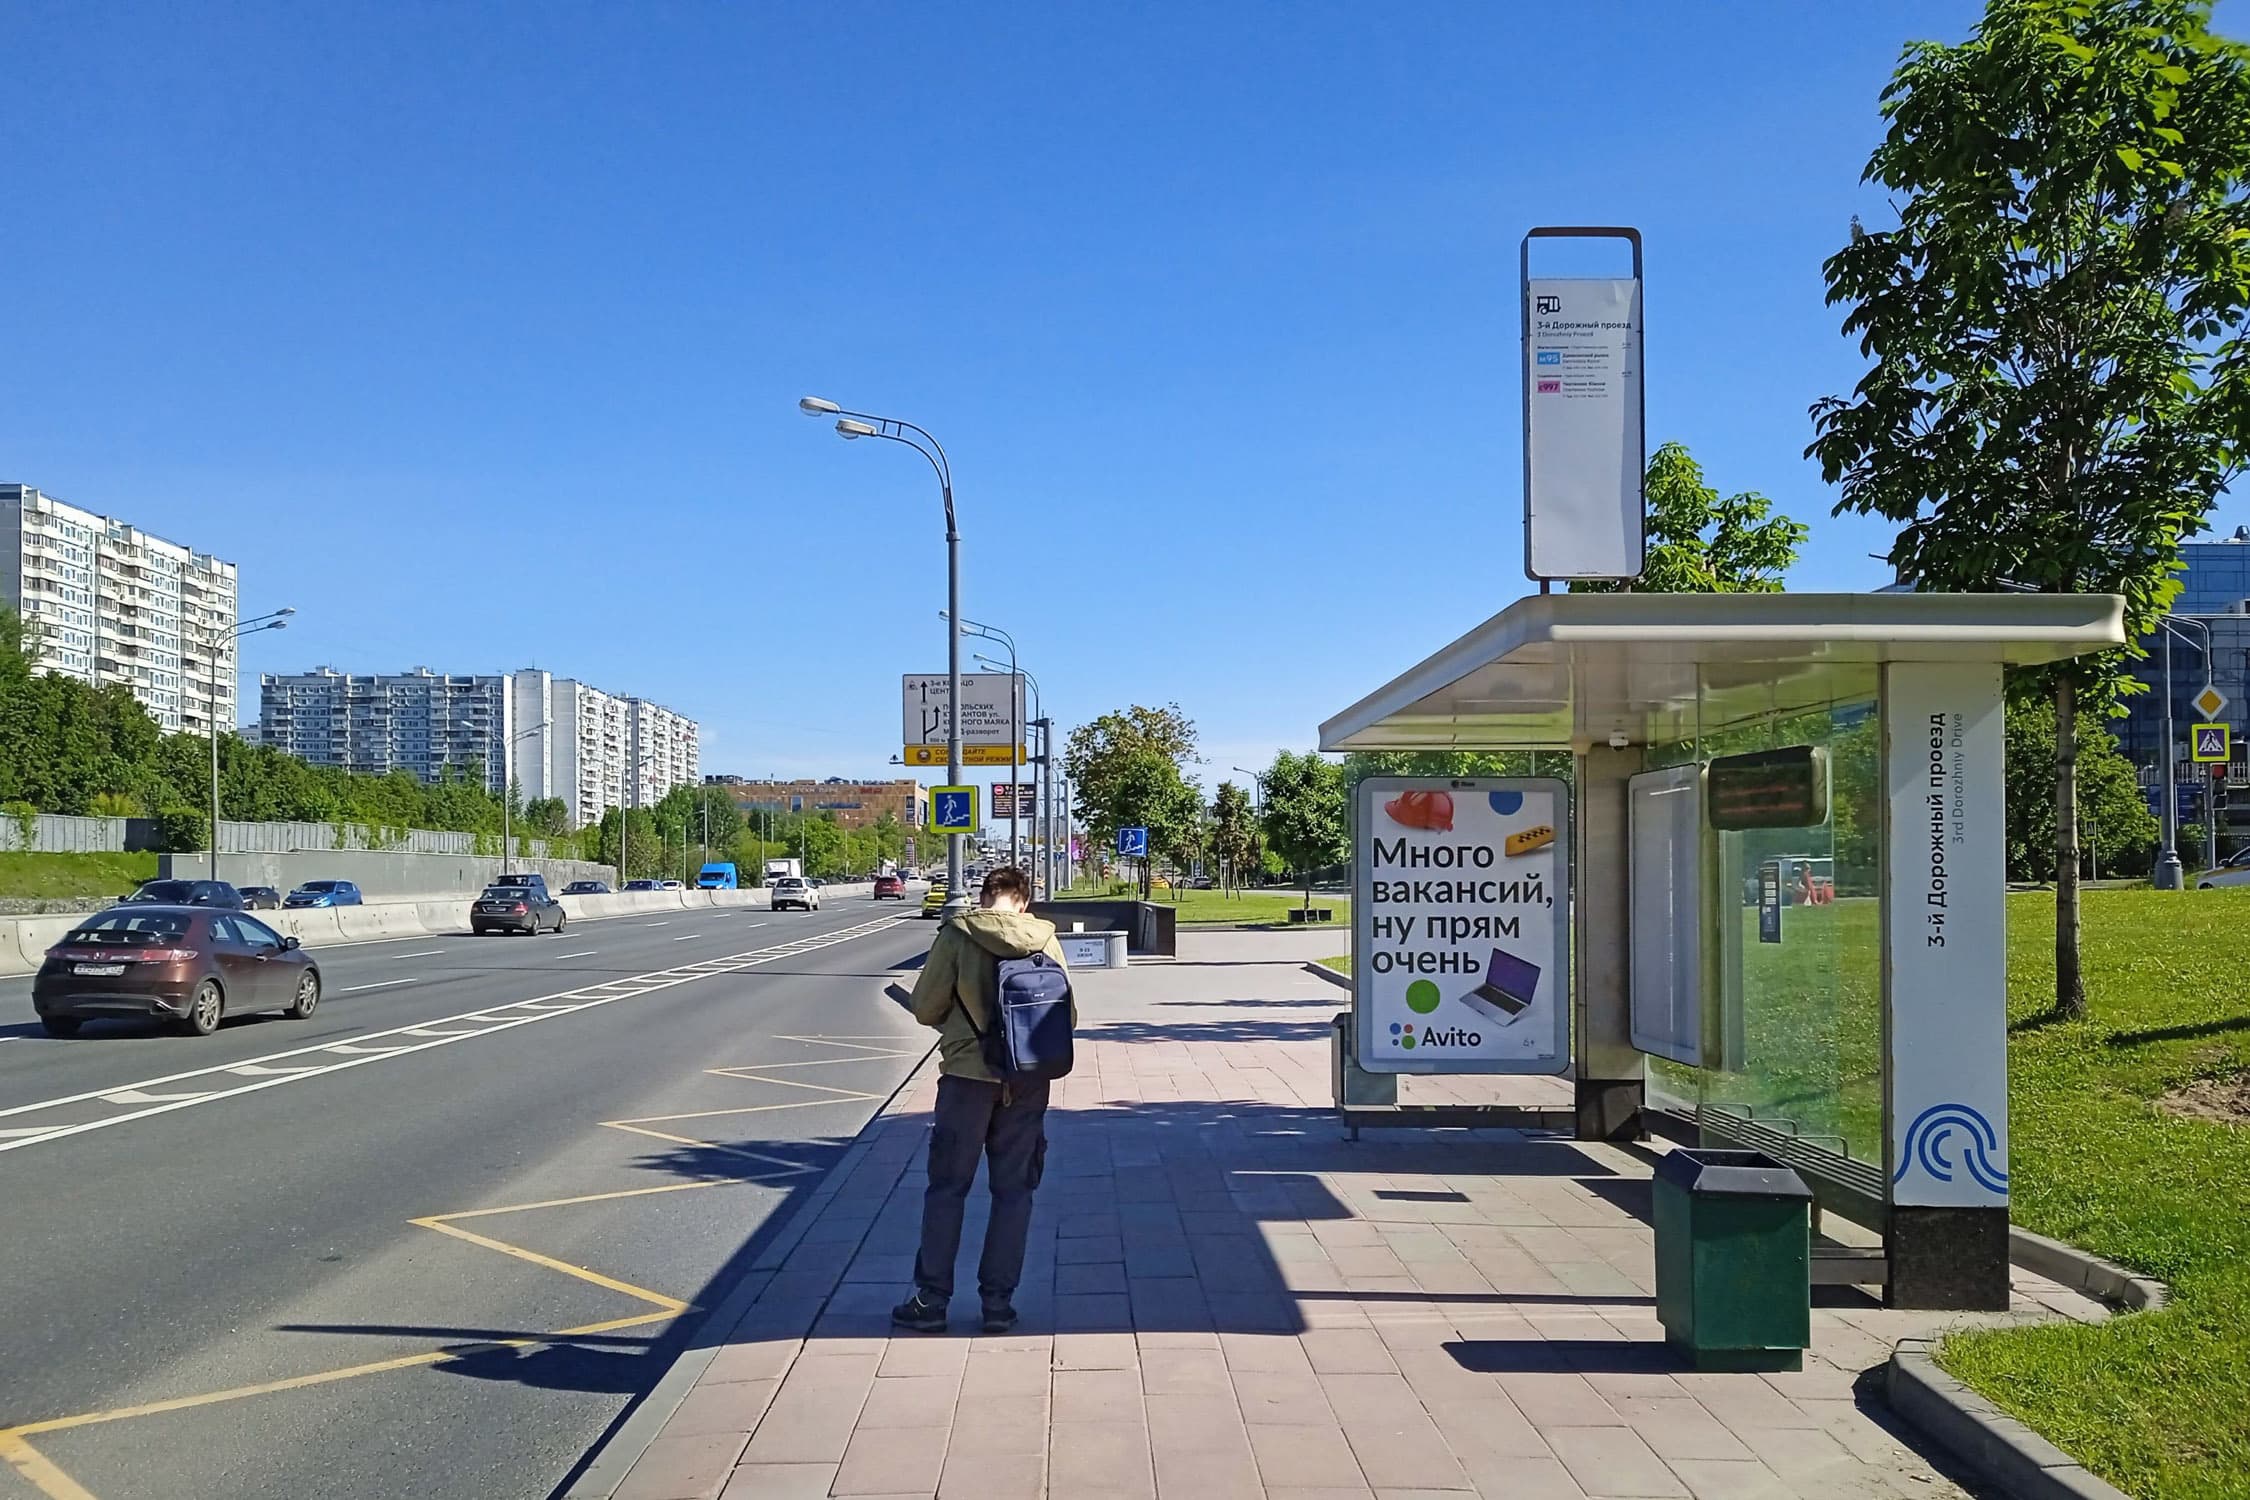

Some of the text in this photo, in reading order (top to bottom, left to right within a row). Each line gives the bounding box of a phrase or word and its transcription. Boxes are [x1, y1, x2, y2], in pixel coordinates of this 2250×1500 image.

[1537, 321, 1632, 330] 3-й Дорожный проезд
[1951, 713, 1965, 844] 3rd Dorozhniy Drive
[1926, 713, 1948, 947] 3-й Дорожный проезд
[1373, 836, 1494, 869] Много
[1373, 872, 1554, 909] вакансий,
[1373, 916, 1520, 945] ну прям
[1371, 951, 1480, 974] очень
[1421, 1026, 1482, 1047] Avito
